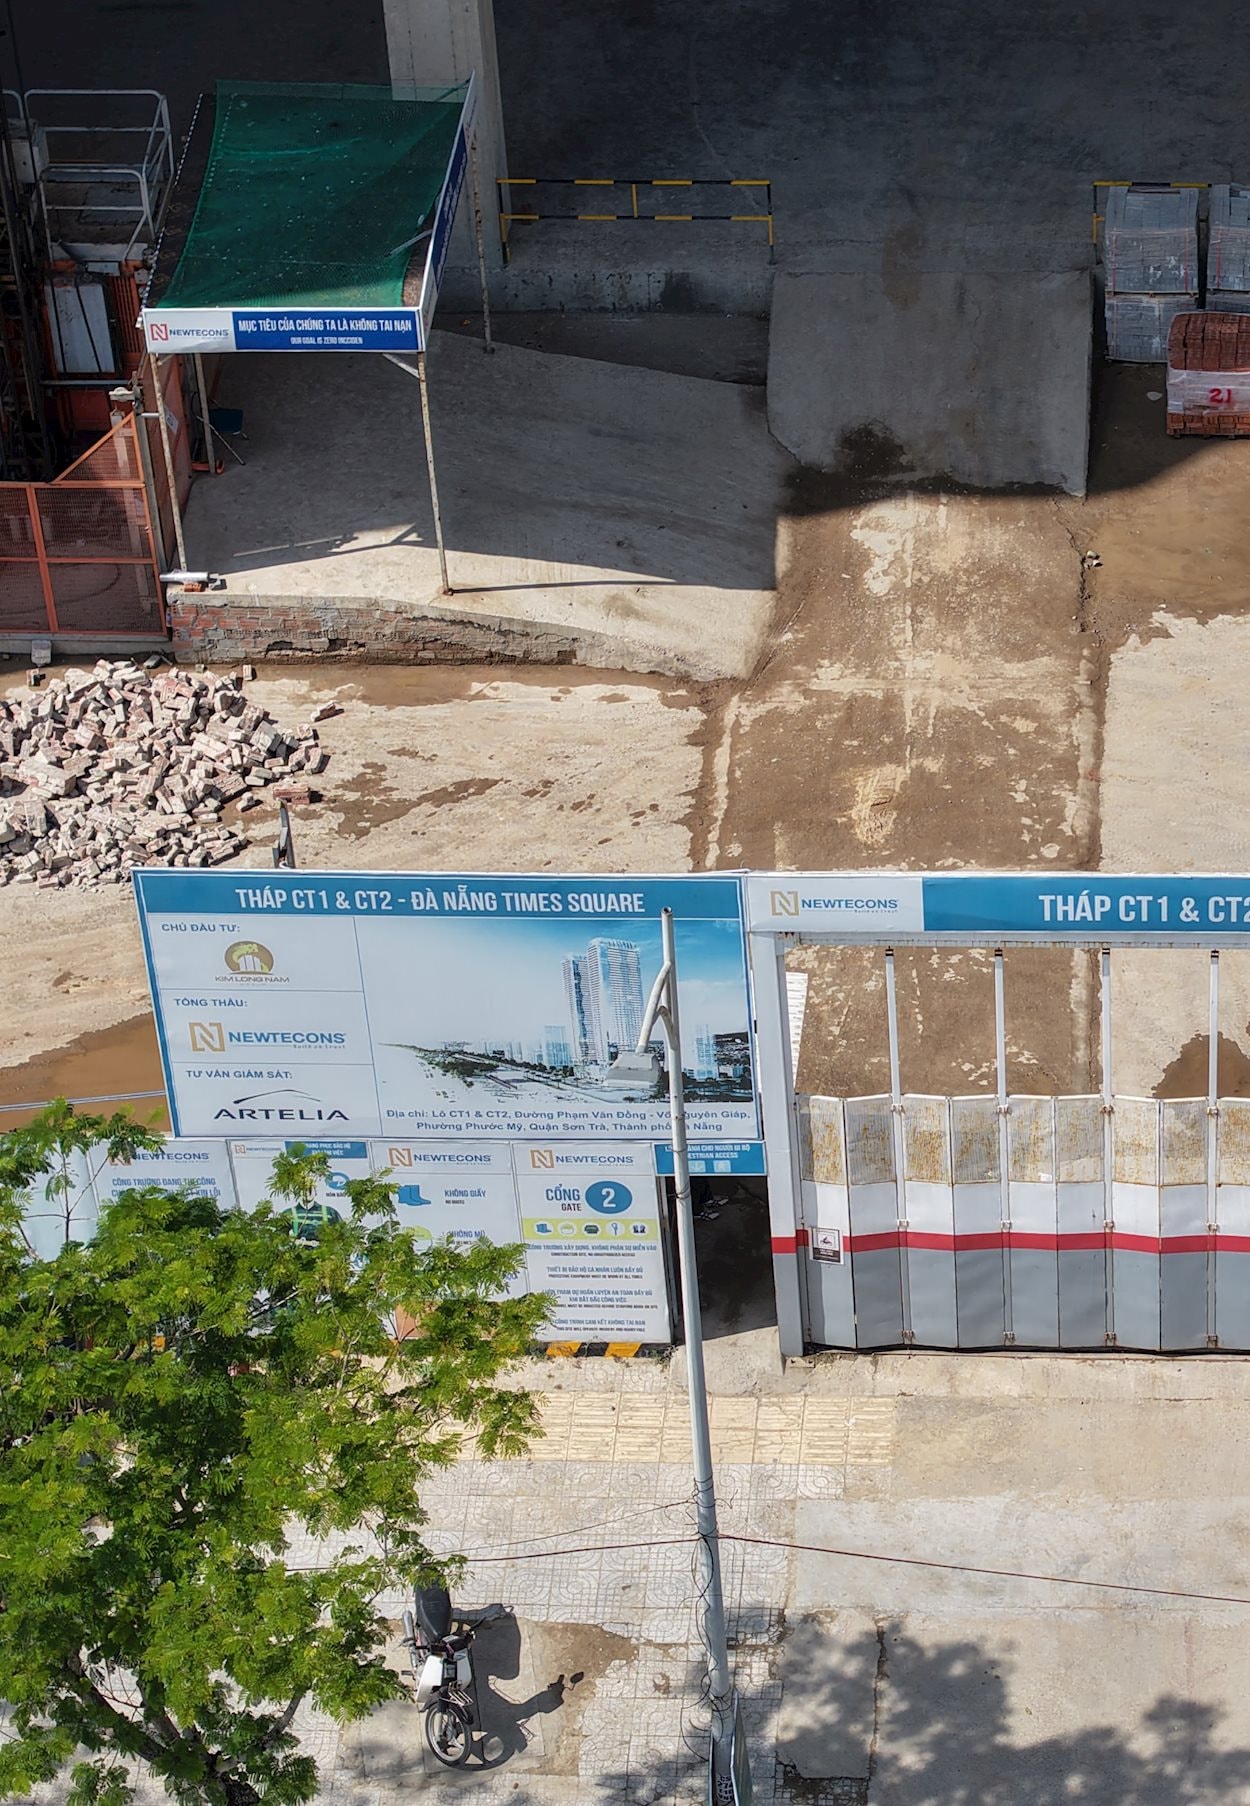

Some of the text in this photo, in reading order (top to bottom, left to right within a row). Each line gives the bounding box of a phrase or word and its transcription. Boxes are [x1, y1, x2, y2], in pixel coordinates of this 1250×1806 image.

[238, 316, 412, 333] MỤC TIÊU CỦA CHÚNG TA LÀ KHÔNG TAI NẠN
[169, 329, 229, 337] NEWTECONS
[1209, 388, 1232, 404] 21
[235, 885, 287, 909] THÁP
[291, 889, 329, 909] CT1
[335, 891, 350, 909] &
[354, 890, 393, 910] CT2
[411, 887, 439, 911] ĐÀ
[442, 884, 498, 912] NẴNG
[501, 892, 563, 912] TIMES
[567, 893, 645, 913] SQUARE
[801, 899, 898, 909] NEWTECONS
[1039, 890, 1111, 922] THÁP
[1119, 895, 1168, 922] CT1
[1179, 897, 1200, 922] &
[161, 922, 187, 932] CHỦ
[228, 1032, 346, 1044] NEWTECONS
[214, 1109, 350, 1120] ARTELIA
[387, 1110, 405, 1119] Địa
[408, 1110, 428, 1119] chỉ:
[432, 1110, 446, 1118] Lô
[486, 1111, 511, 1119] CT2,
[514, 1111, 554, 1121] Đường
[557, 1111, 589, 1121] Phạm
[591, 1111, 613, 1119] Văn
[616, 1110, 647, 1121] Đồng
[682, 1111, 718, 1121] guyên
[417, 1122, 462, 1132] Phường
[466, 1122, 504, 1131] Phước
[507, 1122, 526, 1132] Mỹ,
[529, 1122, 559, 1133] Quận
[562, 1123, 585, 1131] Sơn
[612, 1123, 648, 1131] Thành
[414, 1154, 491, 1162] NEWTECONS
[556, 1155, 633, 1163] NEWTECONS
[546, 1184, 580, 1201] CỔNG
[602, 1188, 616, 1208] 2
[561, 1203, 582, 1211] GATE
